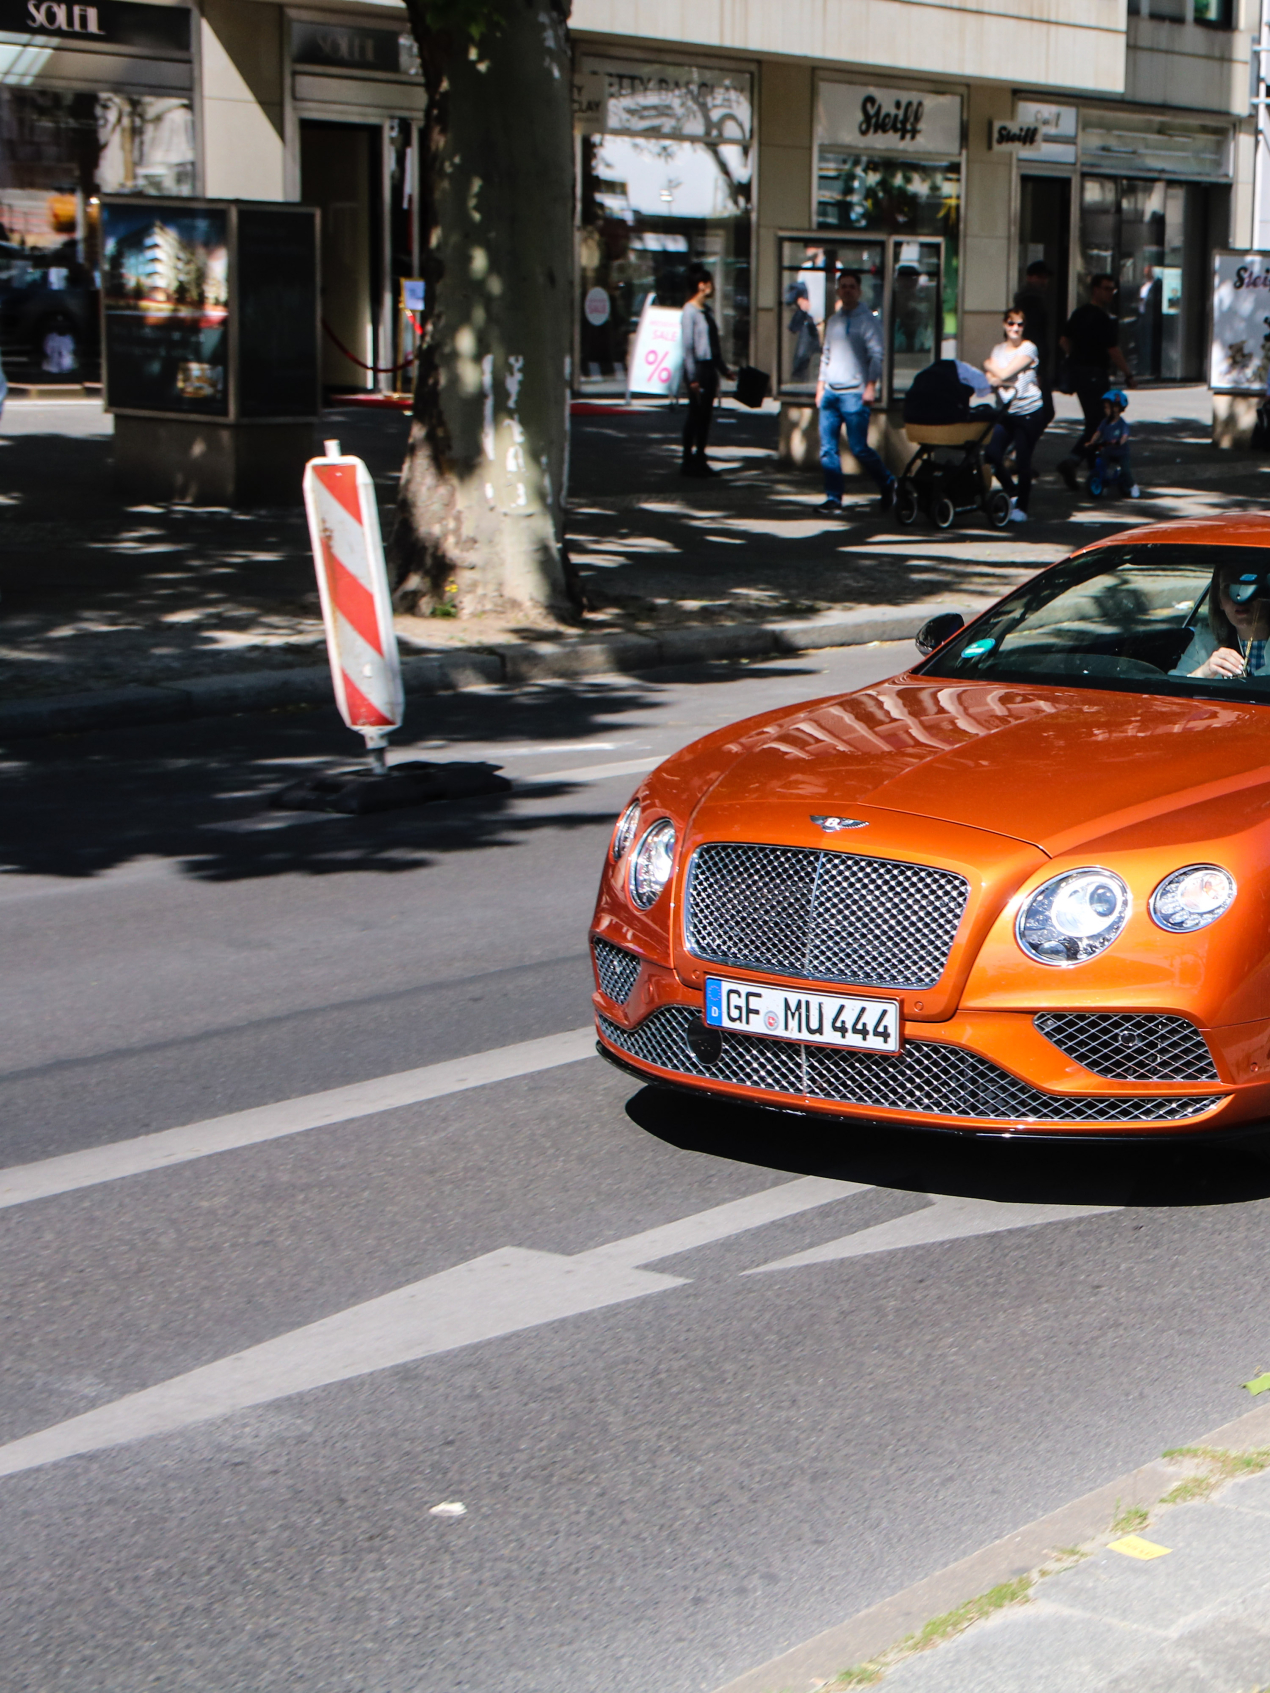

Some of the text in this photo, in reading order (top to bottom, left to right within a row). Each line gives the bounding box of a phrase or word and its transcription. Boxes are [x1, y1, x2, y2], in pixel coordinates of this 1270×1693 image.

[26, 0, 106, 35] SOLEIL
[858, 95, 923, 141] Steiff
[996, 125, 1039, 147] Steiff
[726, 988, 891, 1044] GF MU 444
